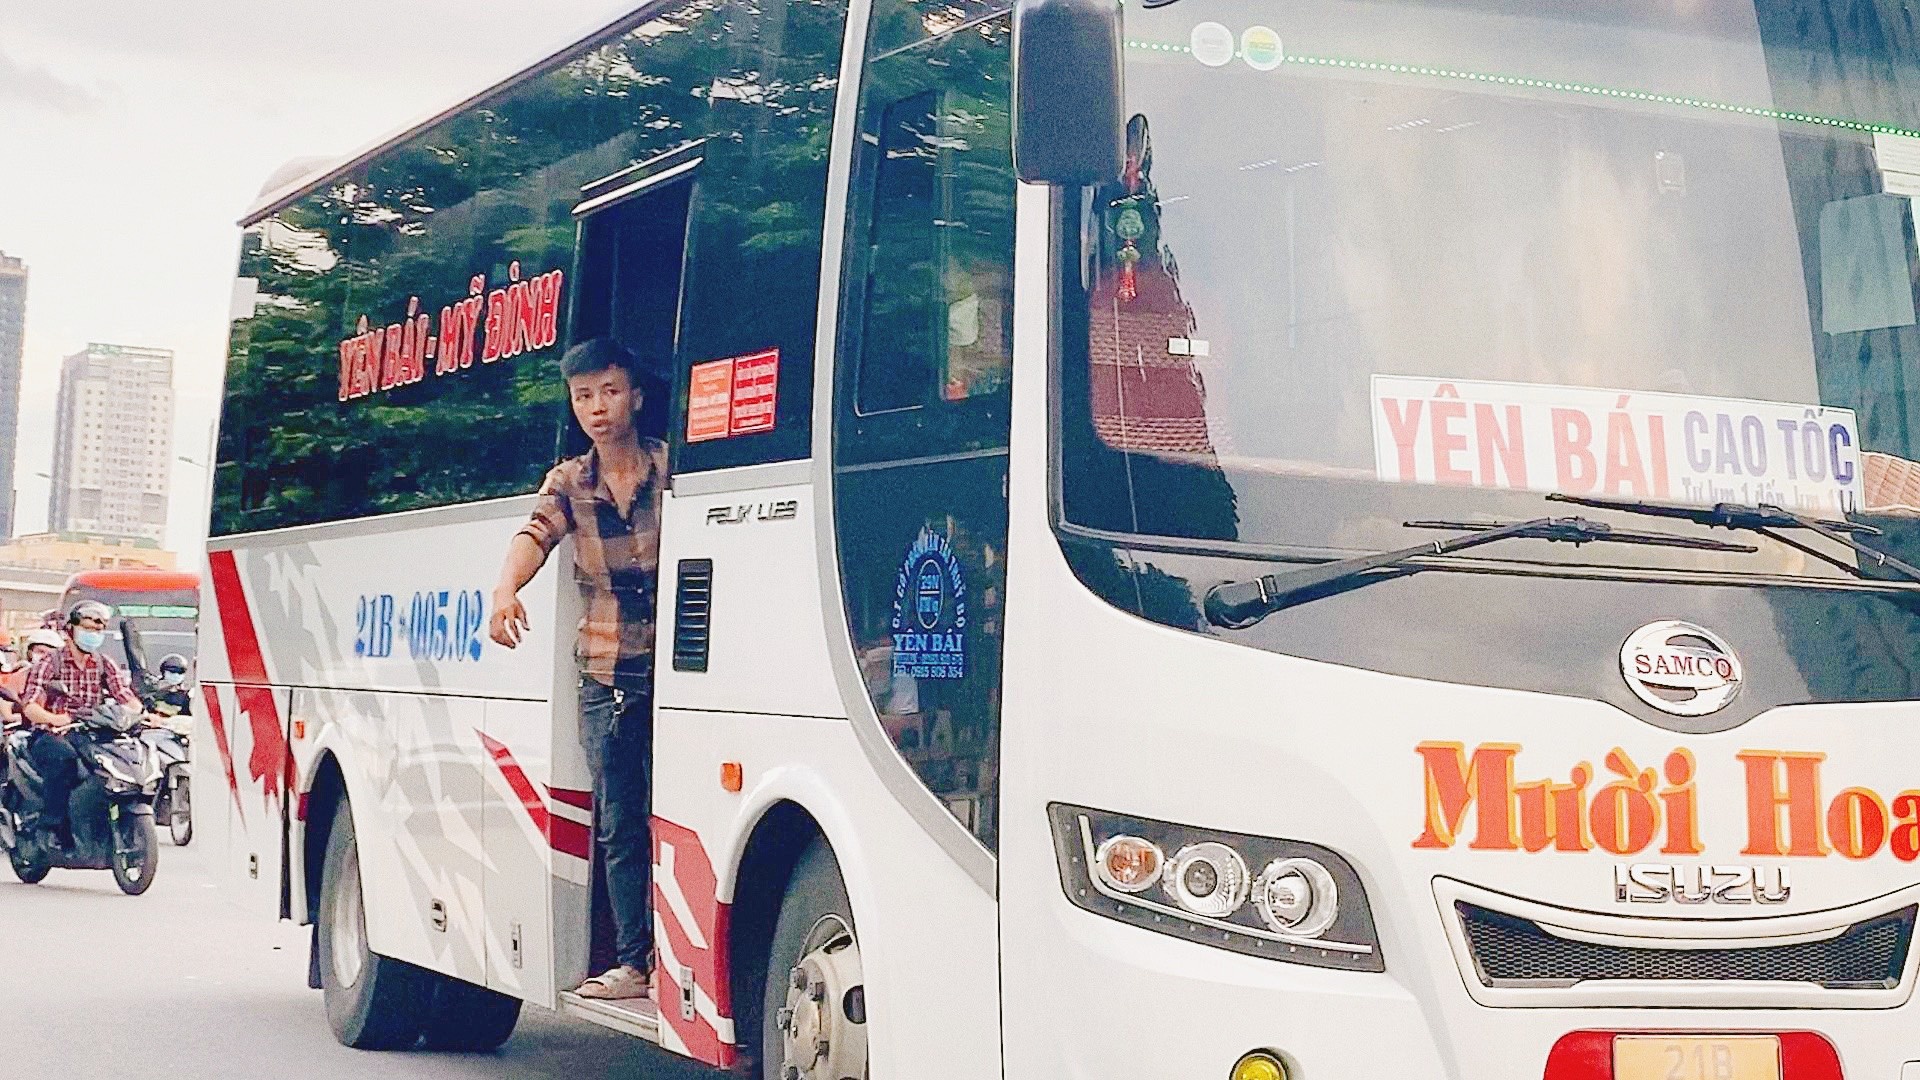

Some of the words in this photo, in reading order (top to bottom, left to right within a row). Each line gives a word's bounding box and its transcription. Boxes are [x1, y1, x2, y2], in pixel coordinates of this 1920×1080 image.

[338, 314, 384, 401] YÊN
[381, 296, 430, 390] BÁI
[436, 273, 484, 375] MỸ
[1381, 383, 1527, 489] YÊN
[1550, 394, 1671, 498] BÁI
[1684, 410, 1767, 478] CAO
[1776, 408, 1855, 486] TỐC
[355, 593, 394, 659] 21B
[409, 589, 482, 662] 005.02
[893, 628, 928, 651] YÊN
[931, 628, 963, 651] BÁI
[1634, 654, 1732, 680] SAMCO
[1411, 739, 1704, 856] Mười
[1614, 863, 1791, 904] ISUZU
[1664, 1044, 1734, 1080] 21B
